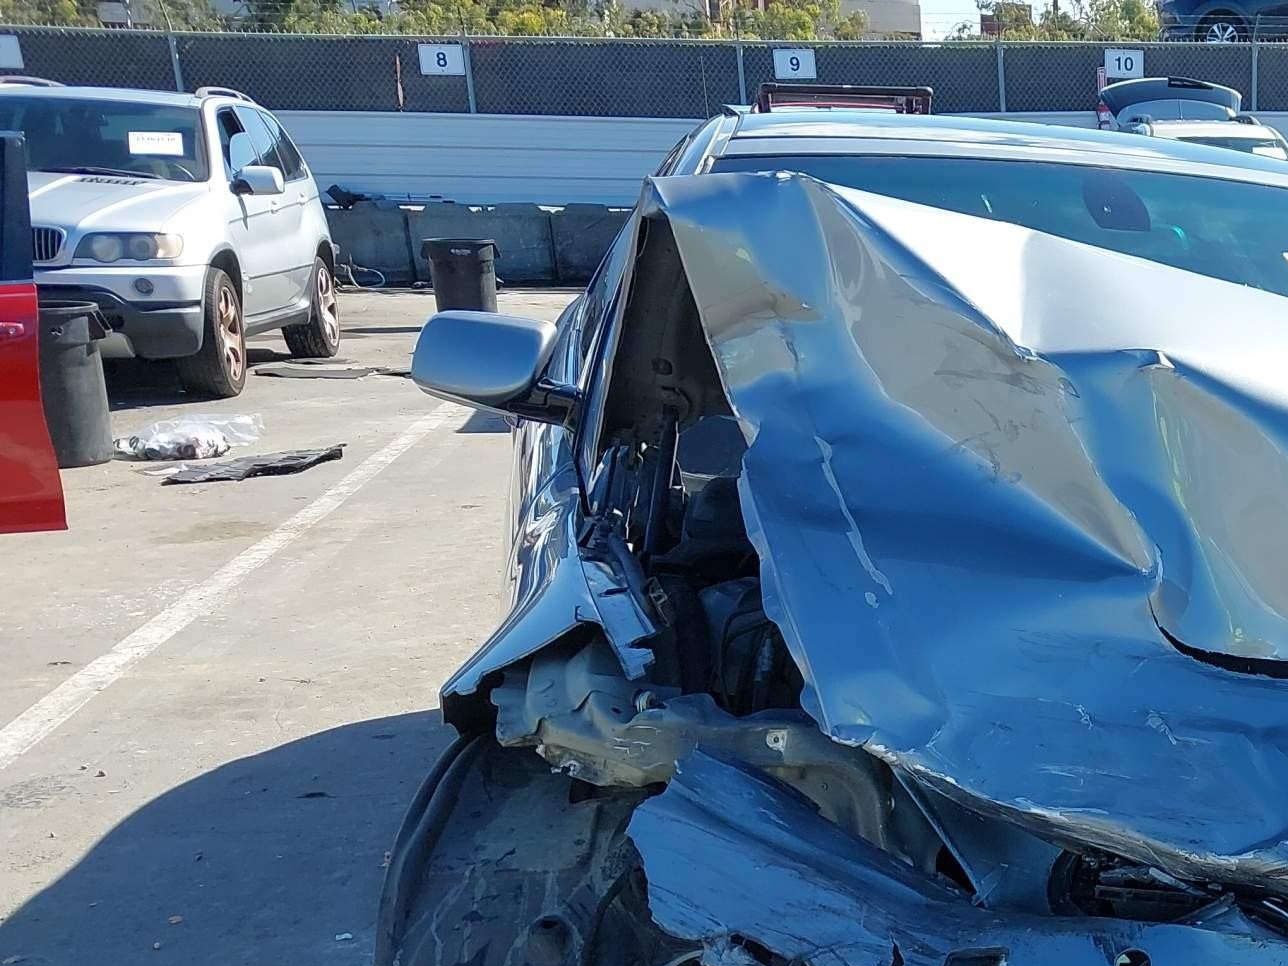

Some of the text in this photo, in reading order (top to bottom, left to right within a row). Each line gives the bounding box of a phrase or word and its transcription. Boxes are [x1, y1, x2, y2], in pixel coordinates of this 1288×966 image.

[436, 52, 447, 67] 8
[789, 56, 800, 71] 9
[1115, 56, 1133, 71] 10
